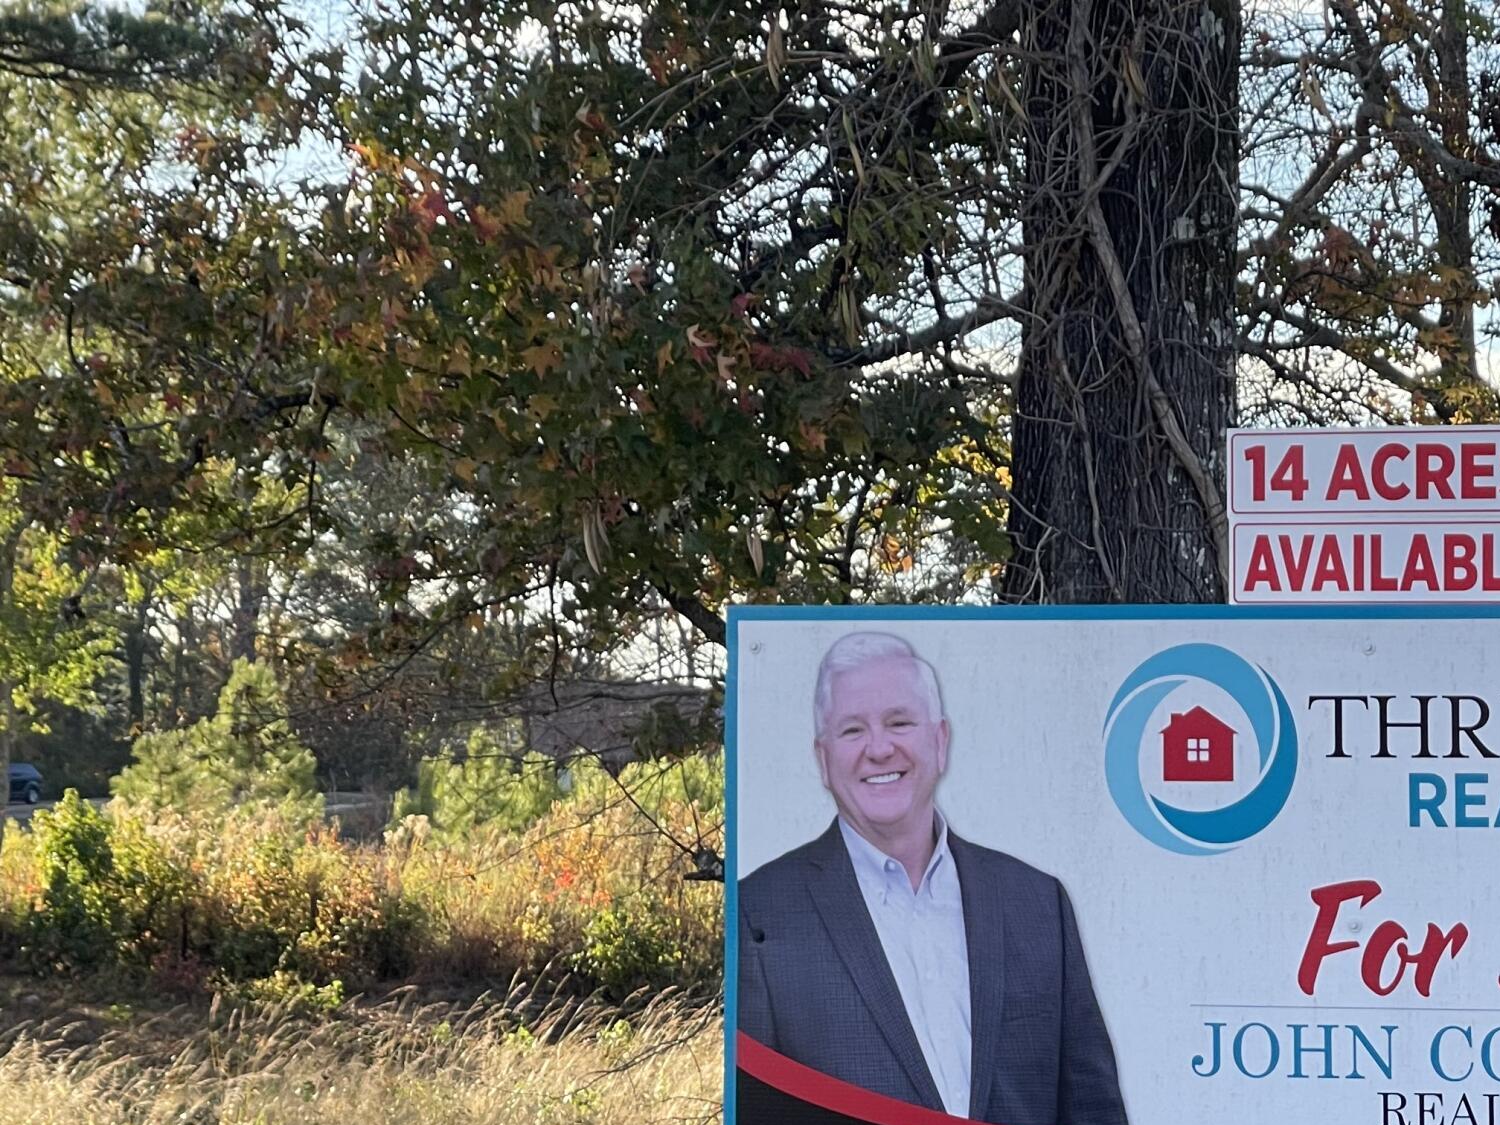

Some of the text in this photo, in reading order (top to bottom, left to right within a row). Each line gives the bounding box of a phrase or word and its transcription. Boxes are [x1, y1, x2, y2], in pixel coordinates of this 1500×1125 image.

[1244, 444, 1309, 503] 14
[1297, 879, 1469, 998] For
[1191, 1022, 1395, 1080] JOHN
